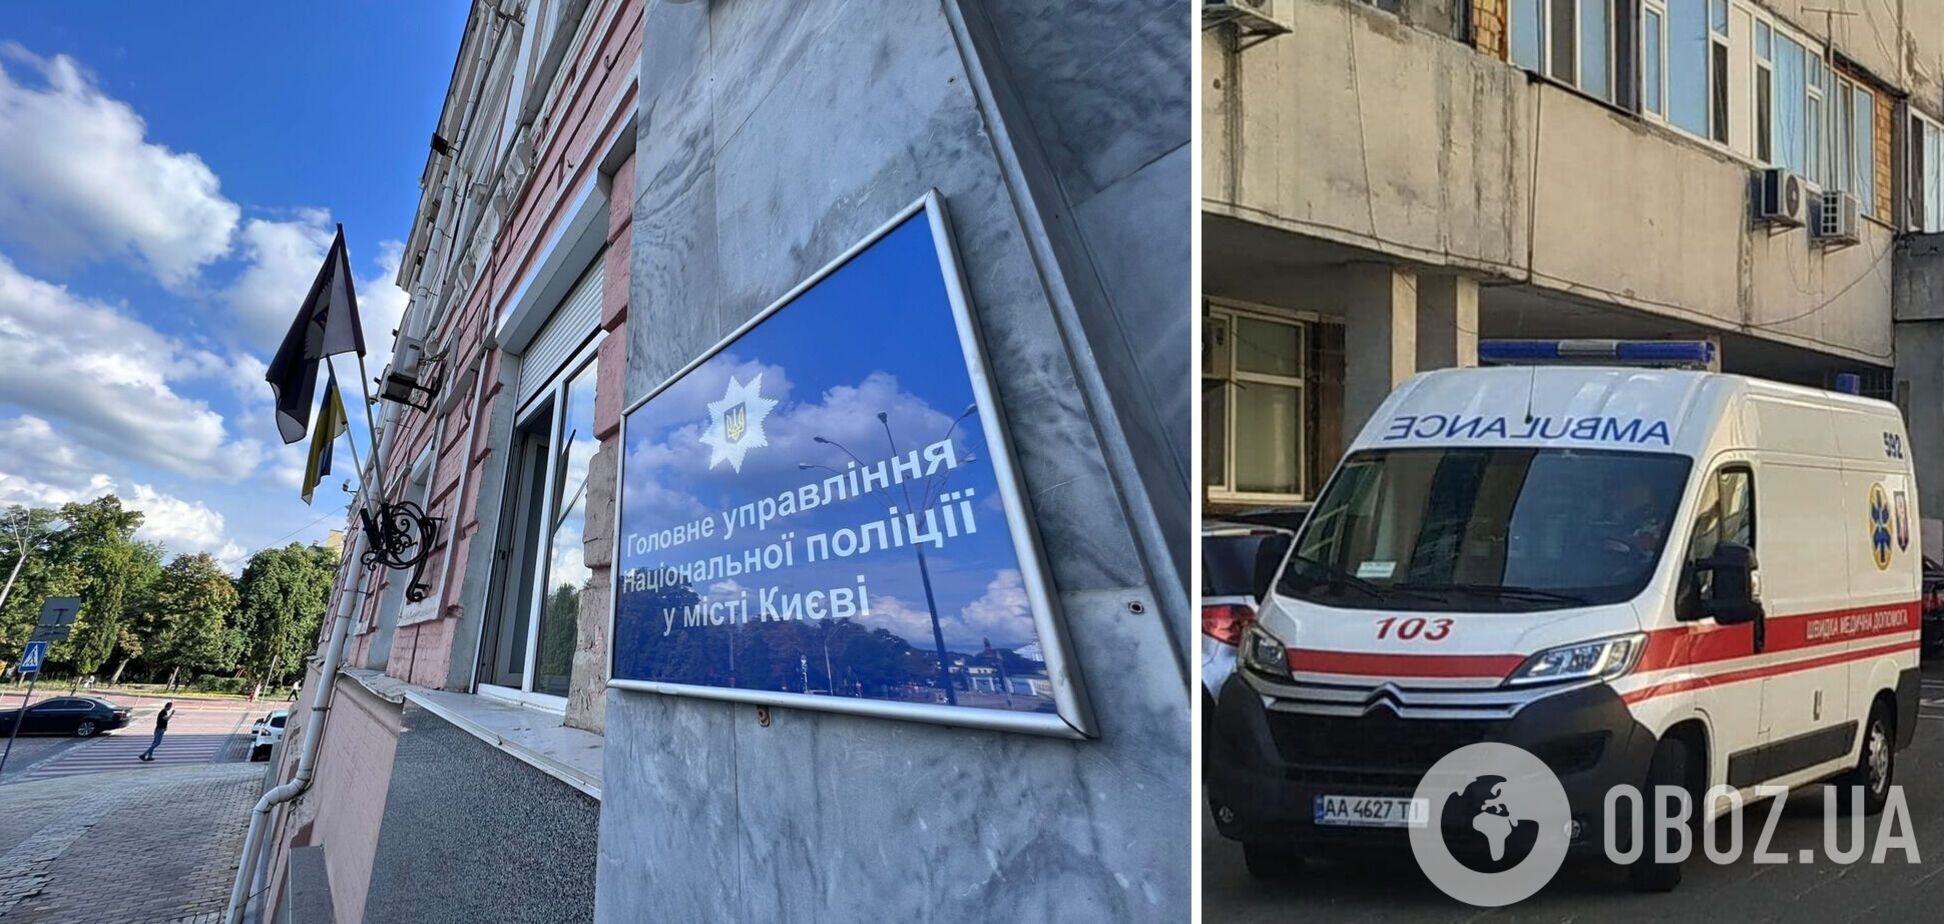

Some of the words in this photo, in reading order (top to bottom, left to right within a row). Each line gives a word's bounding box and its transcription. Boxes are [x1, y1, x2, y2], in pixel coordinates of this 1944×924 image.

[1883, 431, 1904, 459] 592
[626, 515, 715, 558] Головне
[722, 438, 958, 540] управління
[622, 531, 794, 594] Національної
[807, 487, 977, 563] поліції
[662, 607, 676, 637] у
[683, 590, 749, 628] місті
[759, 574, 871, 623] Києві
[1376, 616, 1455, 641] 103
[1806, 617, 1838, 641] ШВИДКА
[1840, 612, 1873, 637] МЕДИЧНА
[1873, 608, 1909, 633] ДОПОМОГА
[1324, 798, 1349, 817] AA
[1353, 800, 1393, 819] 4627
